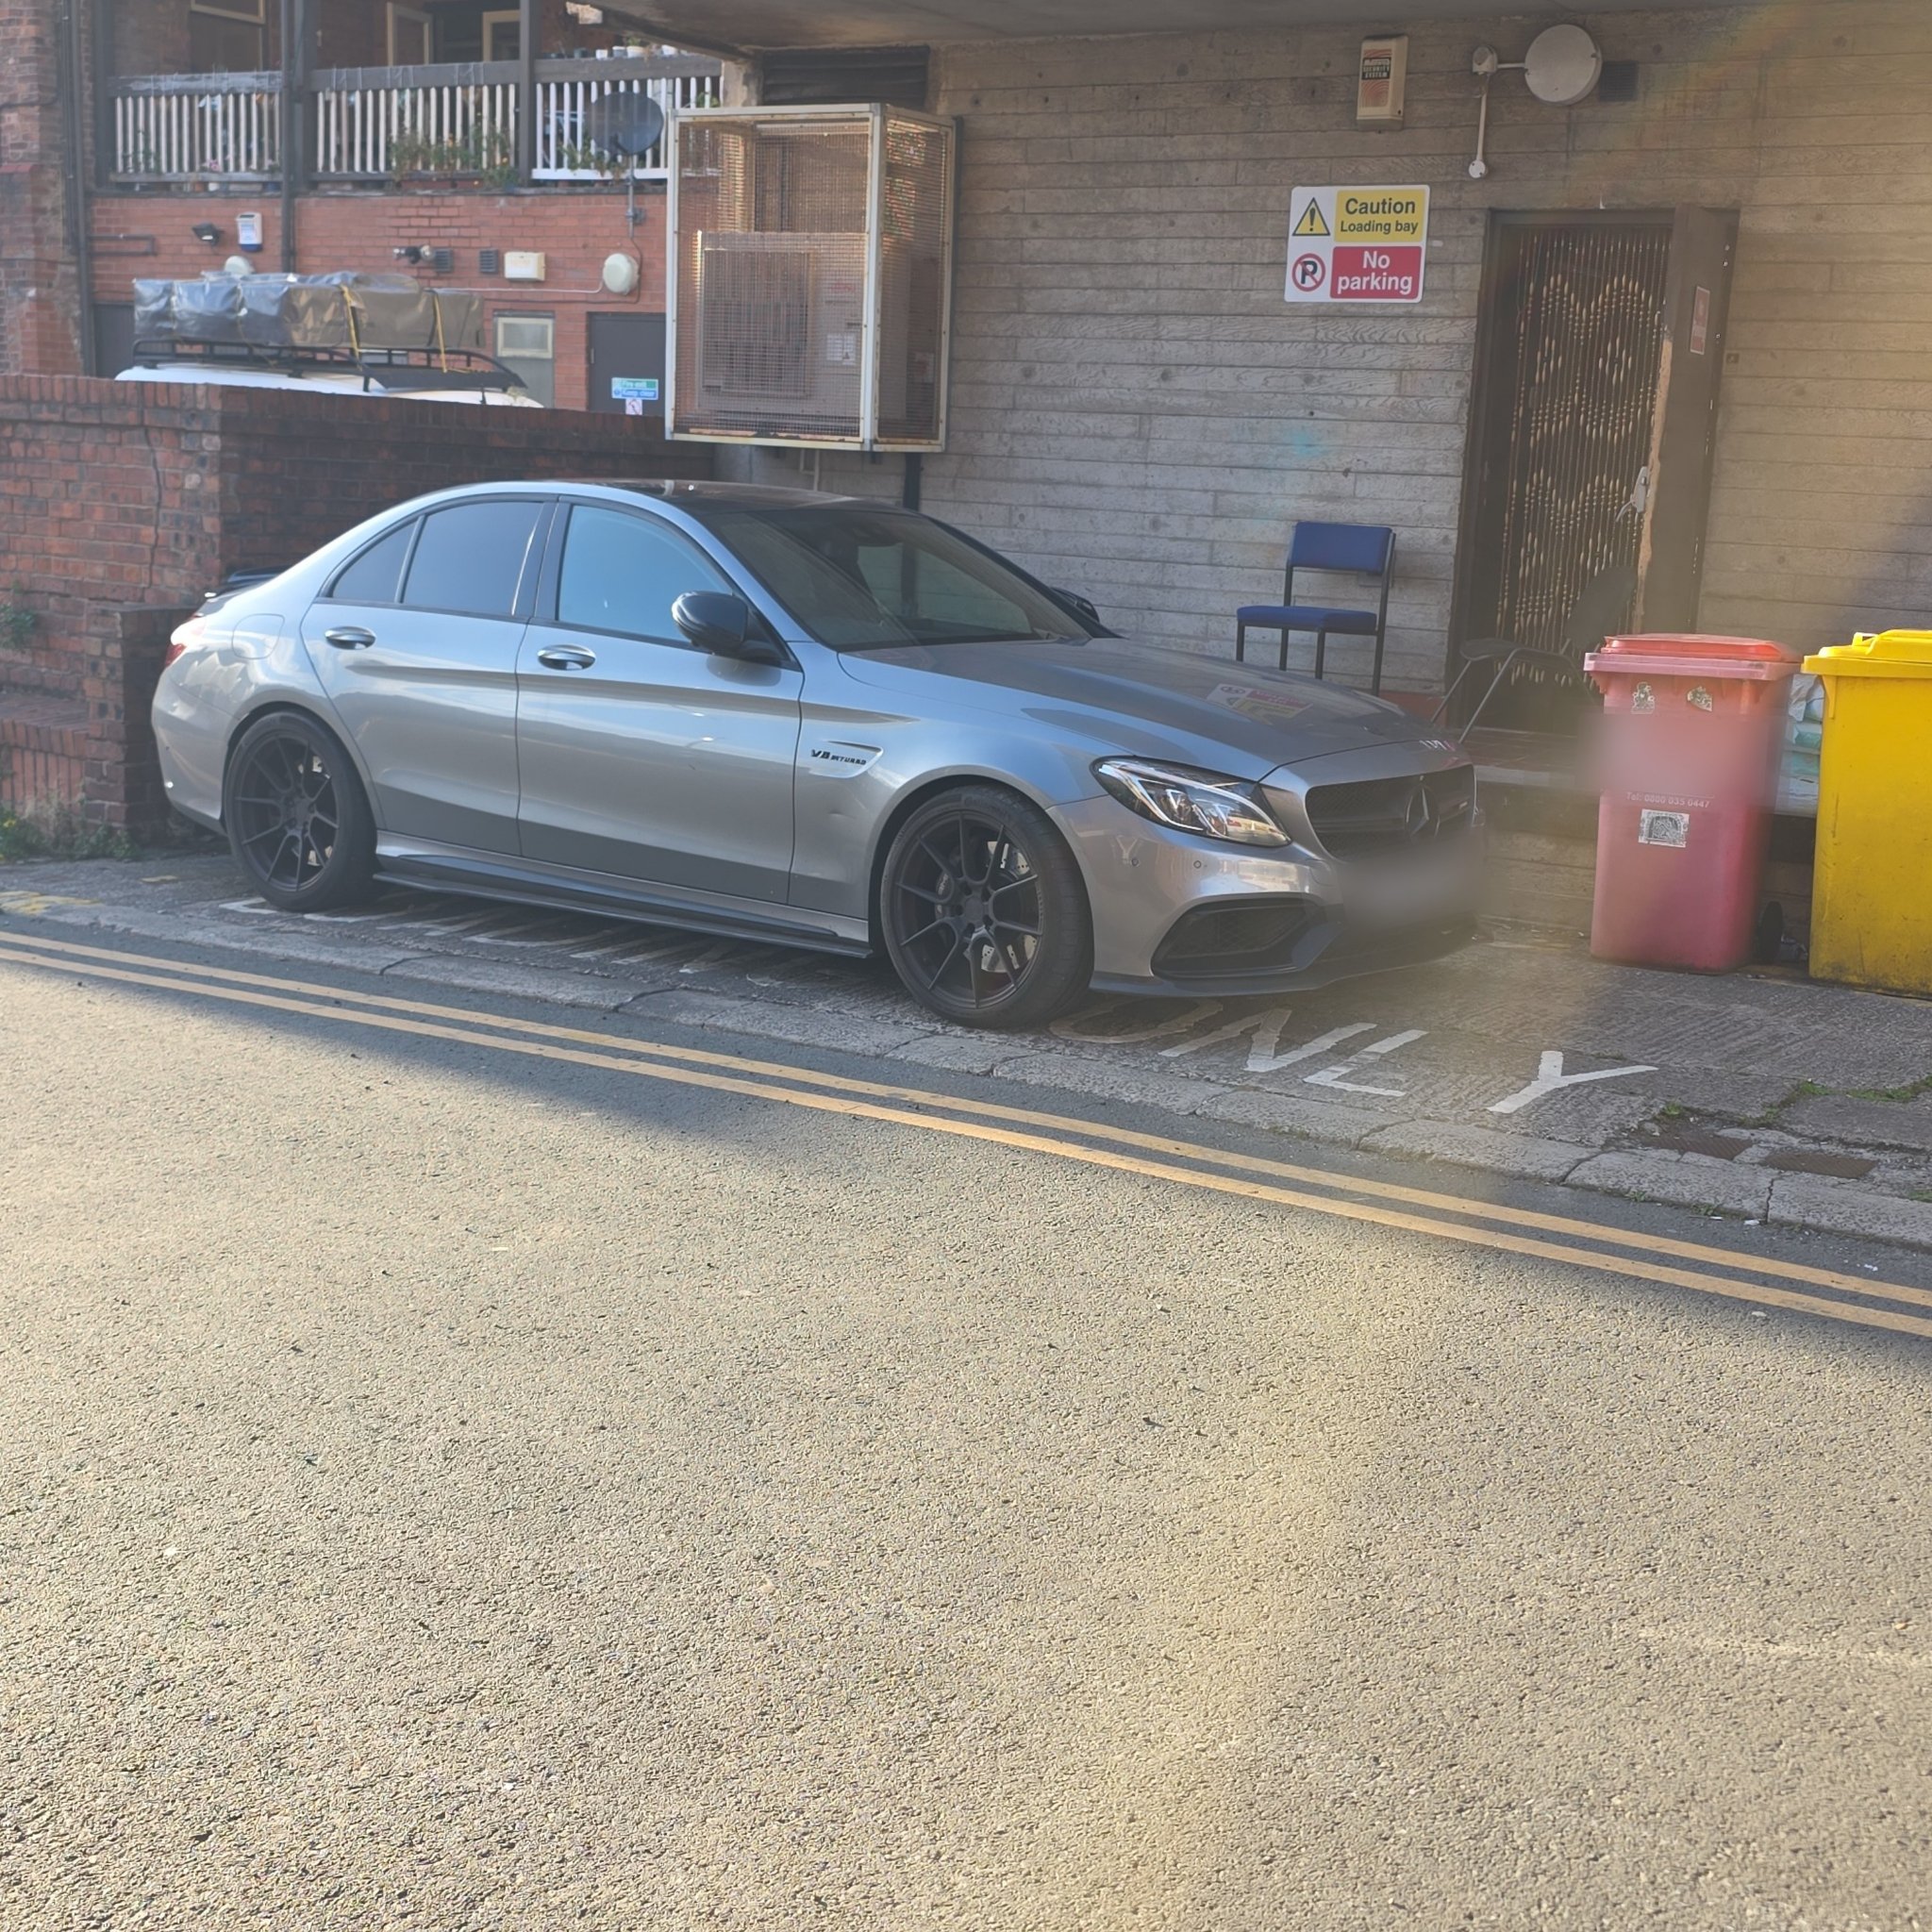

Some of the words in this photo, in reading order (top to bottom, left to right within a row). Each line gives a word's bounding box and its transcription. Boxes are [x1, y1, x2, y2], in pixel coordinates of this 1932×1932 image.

[1345, 197, 1416, 215] Caution
[1341, 220, 1391, 234] Loading
[1394, 220, 1419, 234] bay
[1362, 251, 1391, 269] No
[1337, 272, 1413, 295] parking
[810, 749, 831, 759] V8
[1625, 791, 1641, 801] Tel:
[1687, 798, 1710, 808] 0447
[1048, 996, 1658, 1114] ONLY
